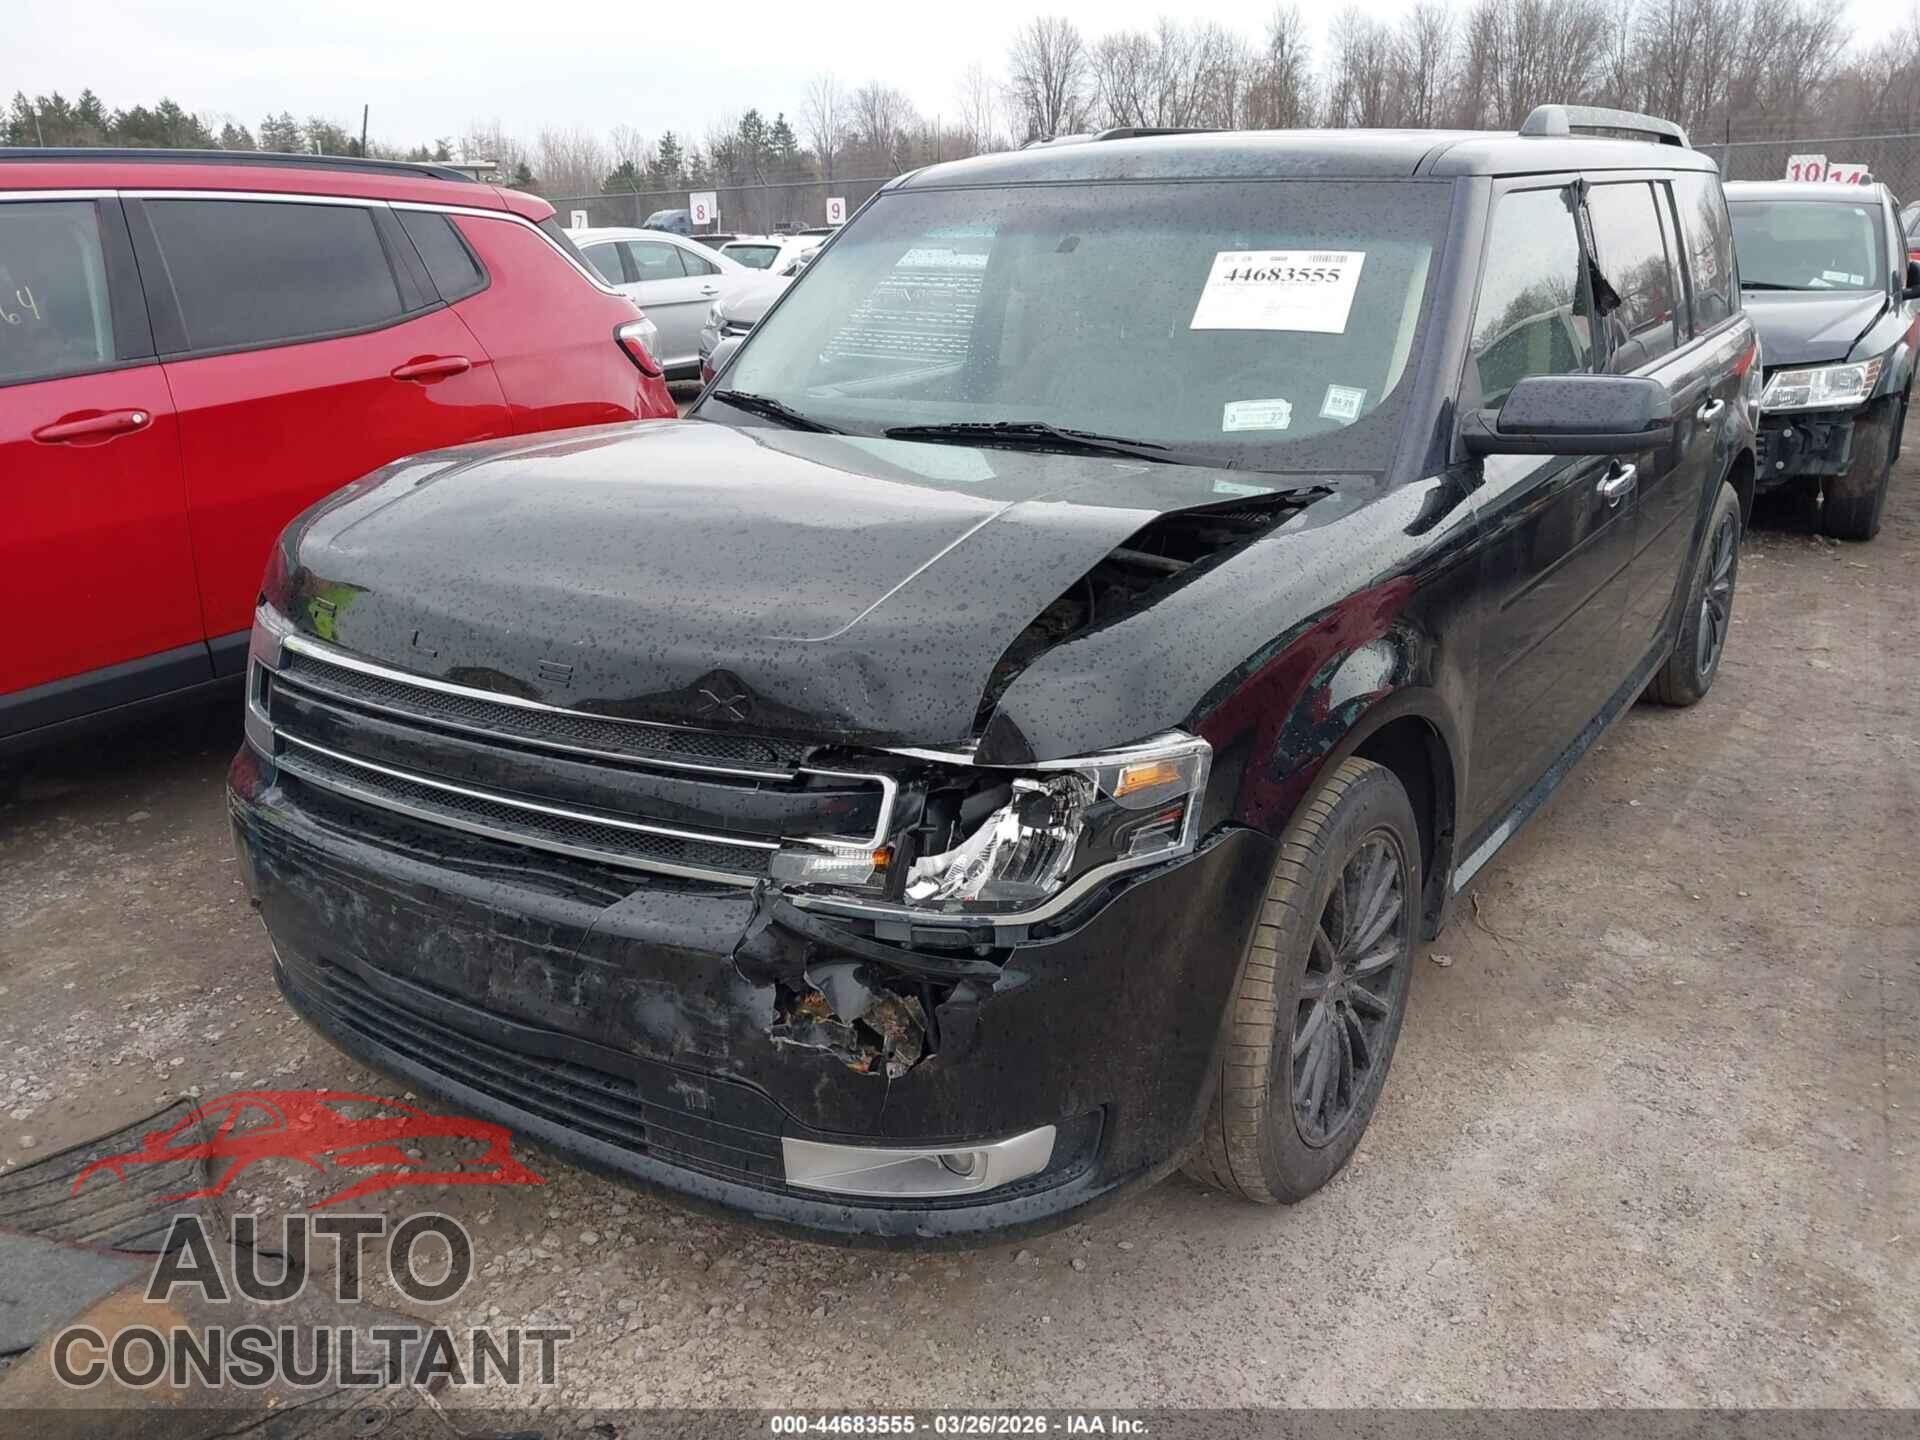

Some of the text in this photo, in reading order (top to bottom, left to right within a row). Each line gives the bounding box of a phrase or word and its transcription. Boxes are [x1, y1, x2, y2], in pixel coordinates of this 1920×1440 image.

[1790, 163, 1821, 182] 10
[696, 204, 705, 220] 8
[831, 202, 840, 219] 9
[575, 215, 583, 230] 7
[1223, 267, 1342, 283] 44683555
